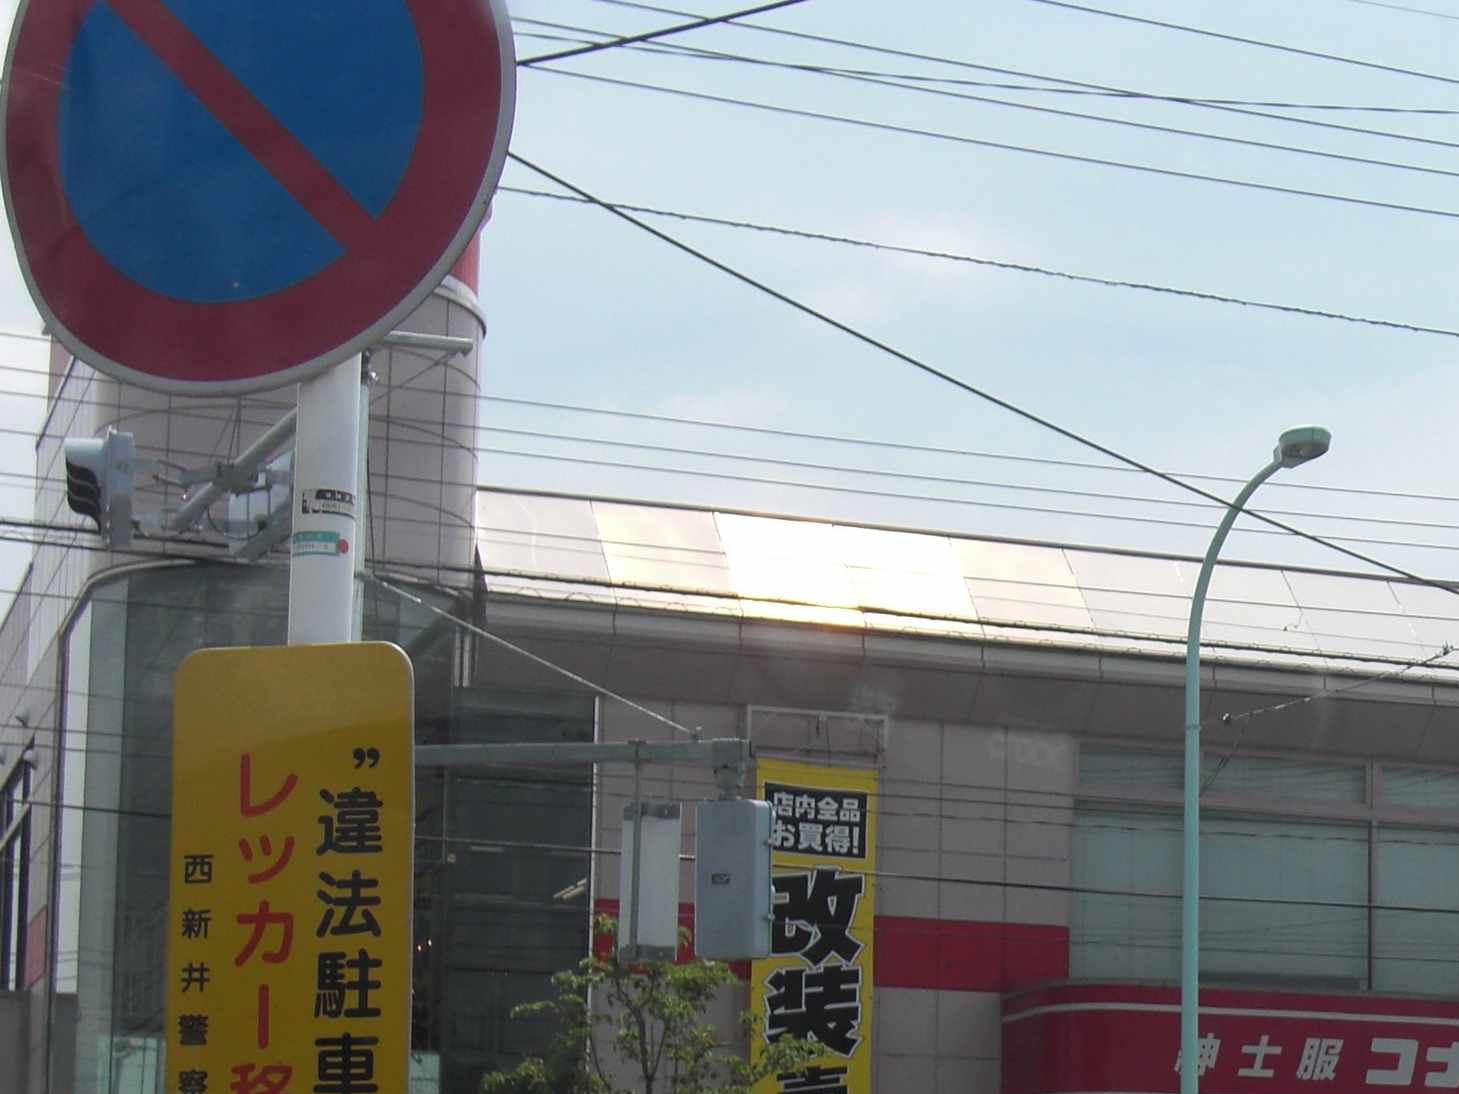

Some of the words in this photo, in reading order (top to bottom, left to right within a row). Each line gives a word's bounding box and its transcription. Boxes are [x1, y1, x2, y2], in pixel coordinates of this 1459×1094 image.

[772, 791, 860, 823] 店内全品
[1173, 1033, 1344, 1081] 紳士服
